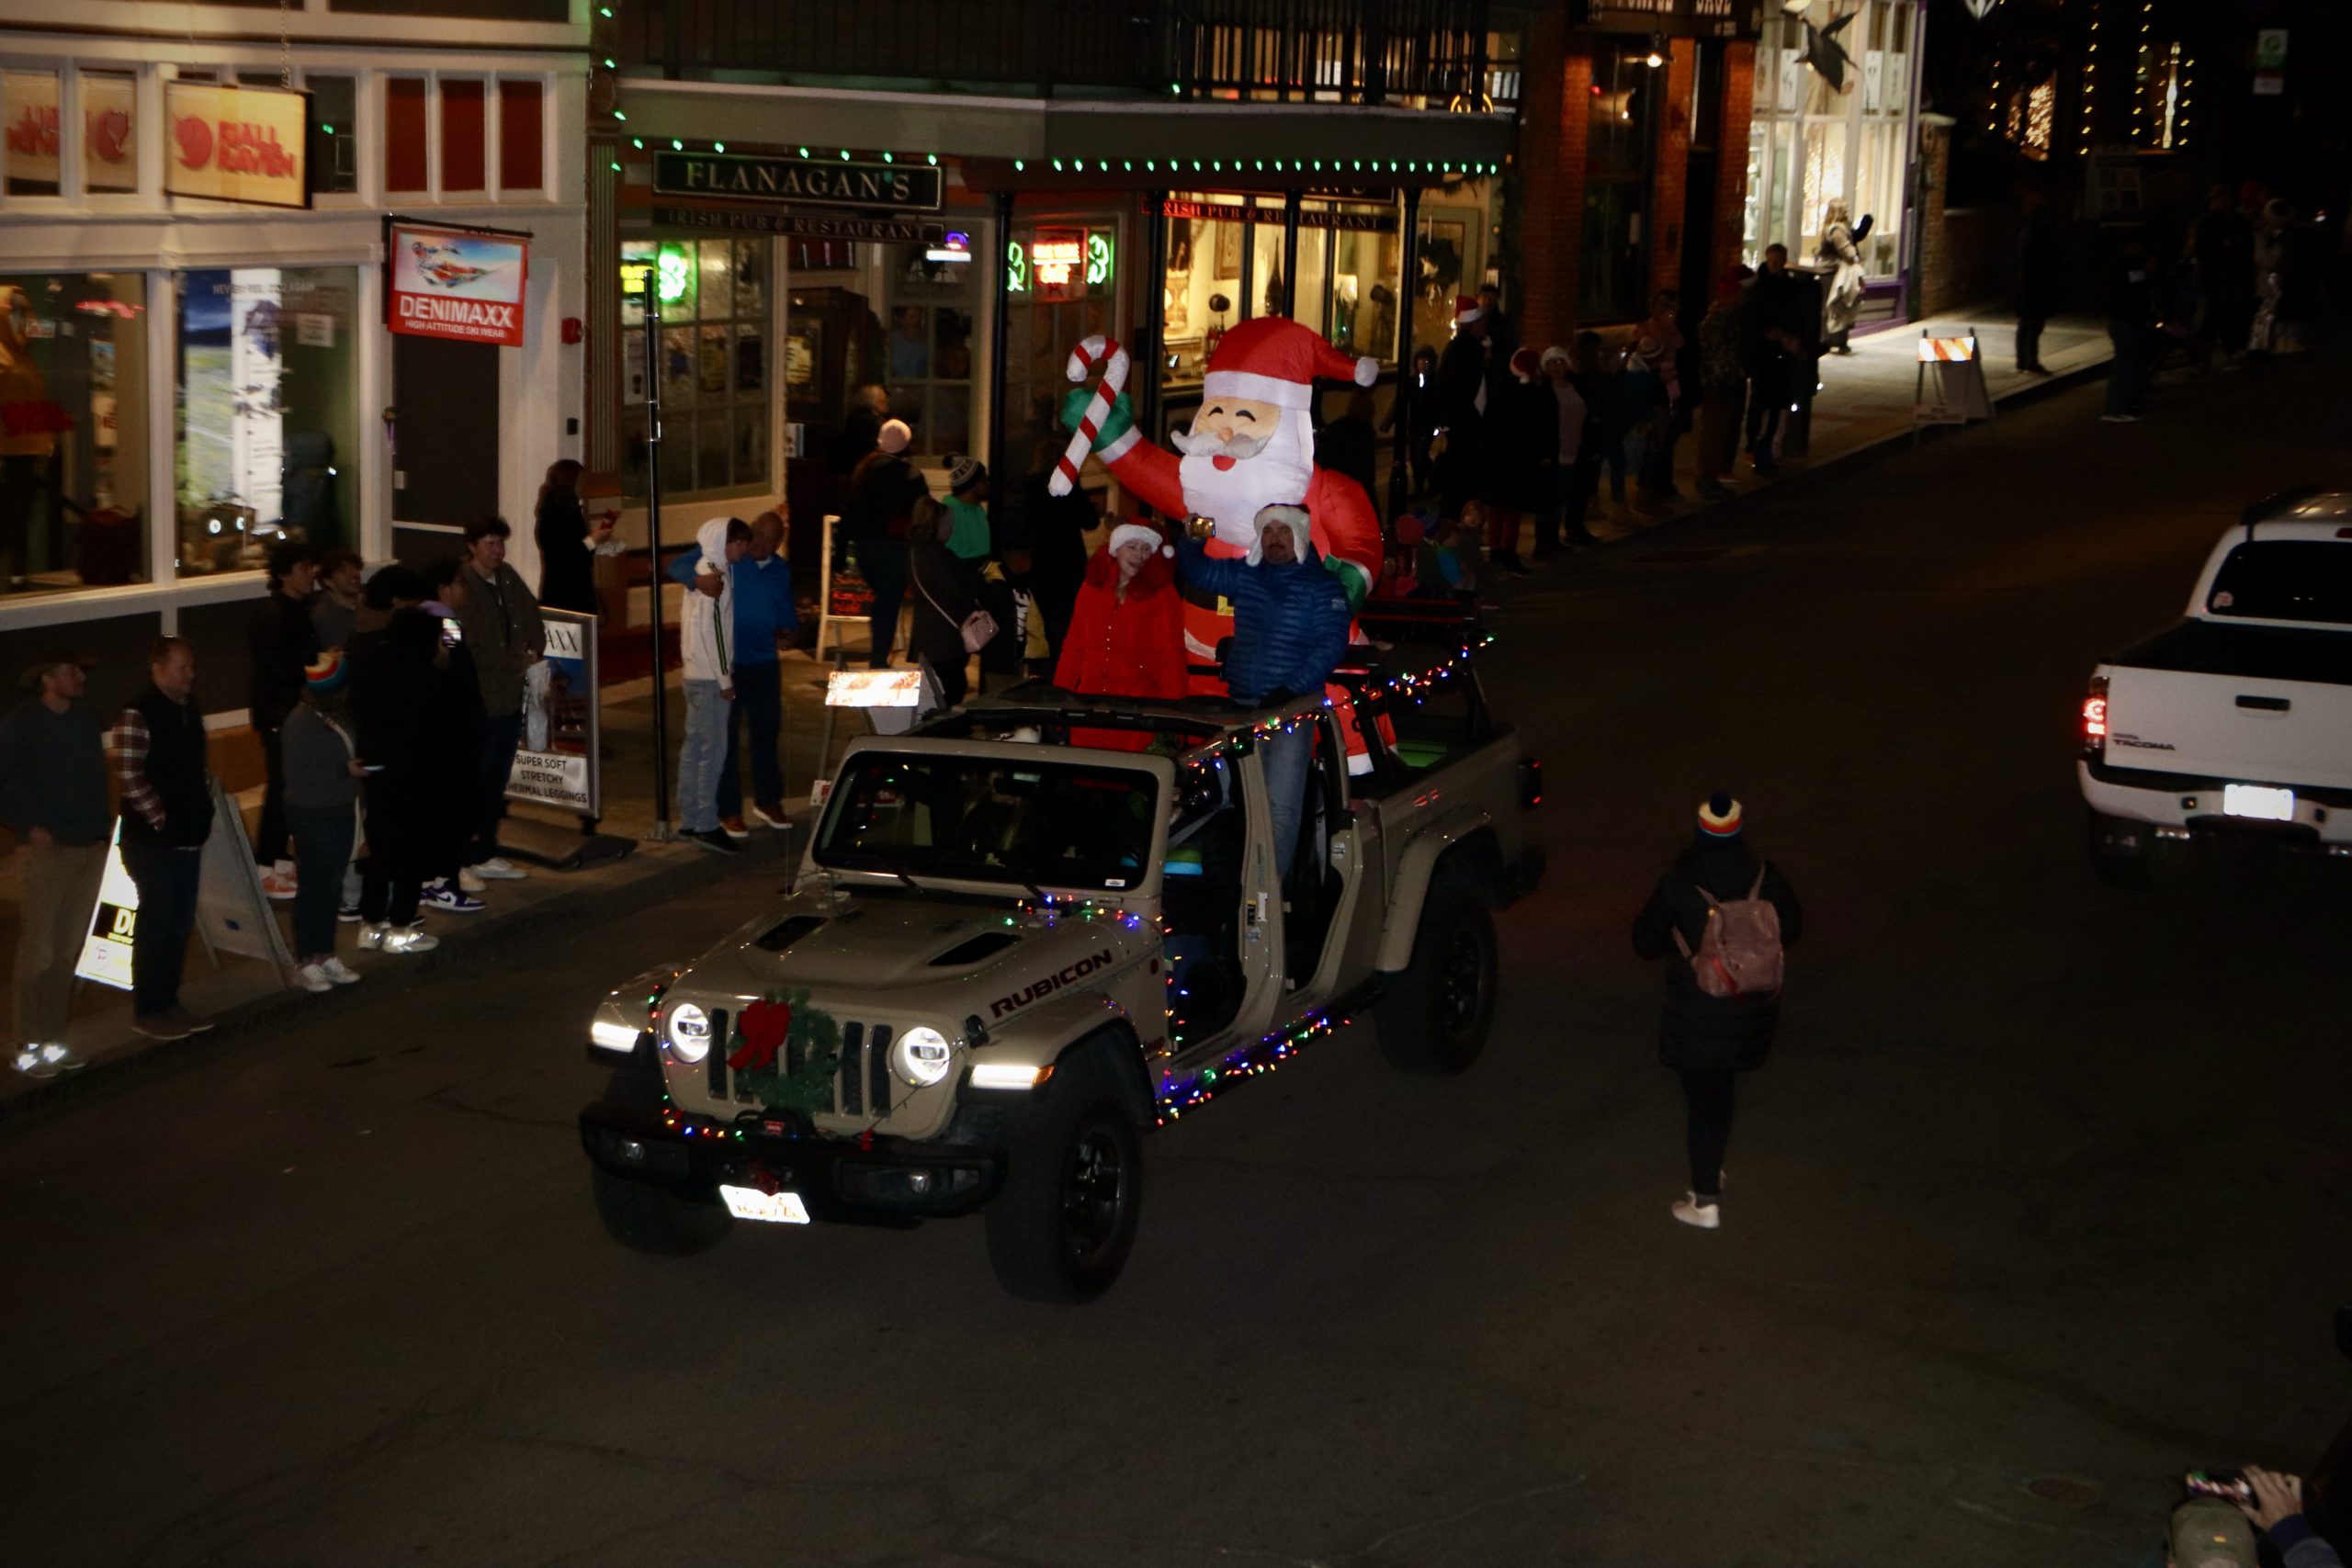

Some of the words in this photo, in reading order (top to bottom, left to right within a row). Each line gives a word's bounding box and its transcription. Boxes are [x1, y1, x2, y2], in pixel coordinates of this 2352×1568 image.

[685, 161, 911, 200] FLANAGAN'S
[668, 209, 721, 226] IRISH
[729, 212, 768, 229] PUB
[794, 217, 927, 240] RESTAURANT
[1163, 201, 1202, 216] RISH
[1208, 205, 1240, 219] PUB
[1263, 209, 1377, 229] RETAURANT
[399, 295, 514, 329] DENIMAXX
[404, 319, 425, 330] HIGH
[466, 325, 480, 335] SKI
[481, 327, 506, 339] WEAR
[2113, 739, 2176, 751] TACOMA
[515, 754, 543, 767] SUPER
[544, 758, 567, 771] SOFT
[520, 770, 564, 785] STRETCHY
[506, 783, 542, 796] HERMAL
[544, 787, 588, 803] LEGGINGS
[989, 948, 1114, 1018] RUBICON
